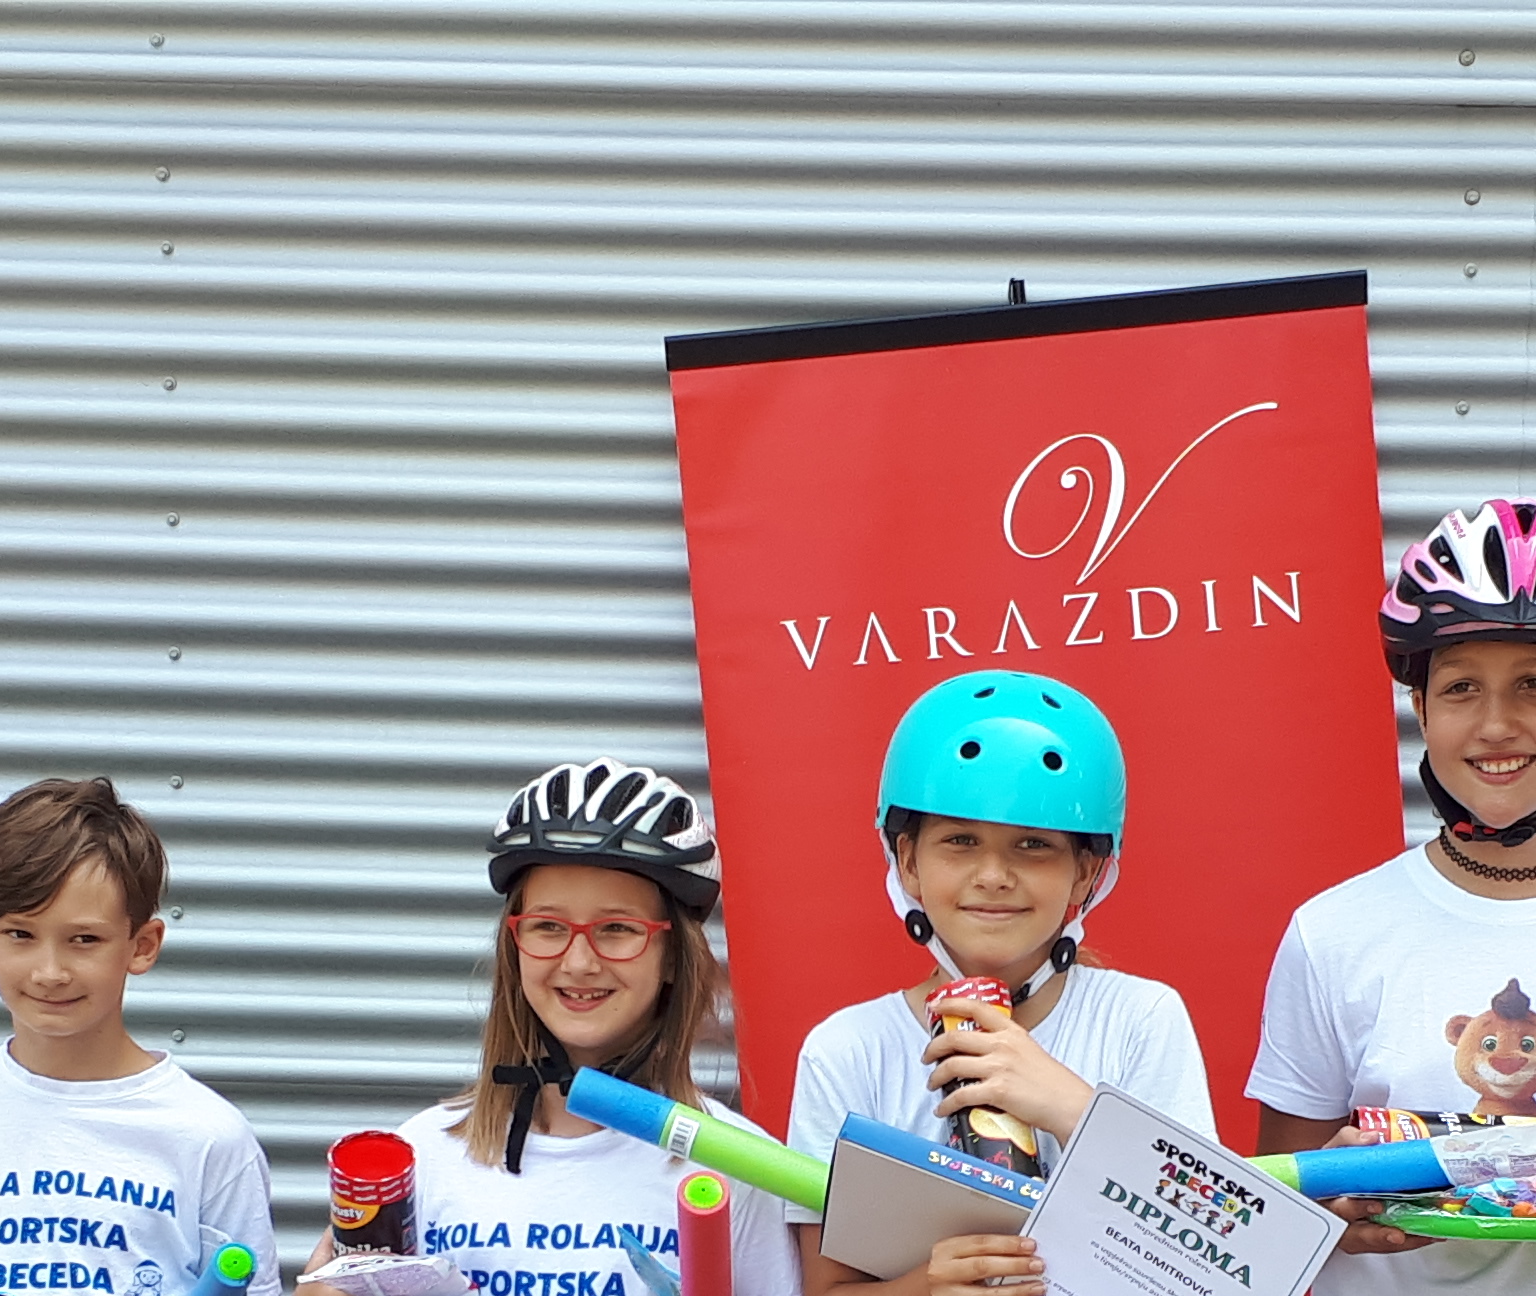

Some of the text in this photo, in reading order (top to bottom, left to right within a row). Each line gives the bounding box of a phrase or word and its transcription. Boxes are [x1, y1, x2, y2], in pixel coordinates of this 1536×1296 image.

[31, 1170, 177, 1218] ROLANJA
[928, 1150, 1015, 1191] SVJETSKA
[1151, 1138, 1266, 1215] SPORTSKA
[1160, 1161, 1252, 1227] ABECEDA
[424, 1222, 511, 1256] ŠKOLA
[1099, 1177, 1252, 1289] DIPLOMA
[1105, 1226, 1141, 1255] BEATA
